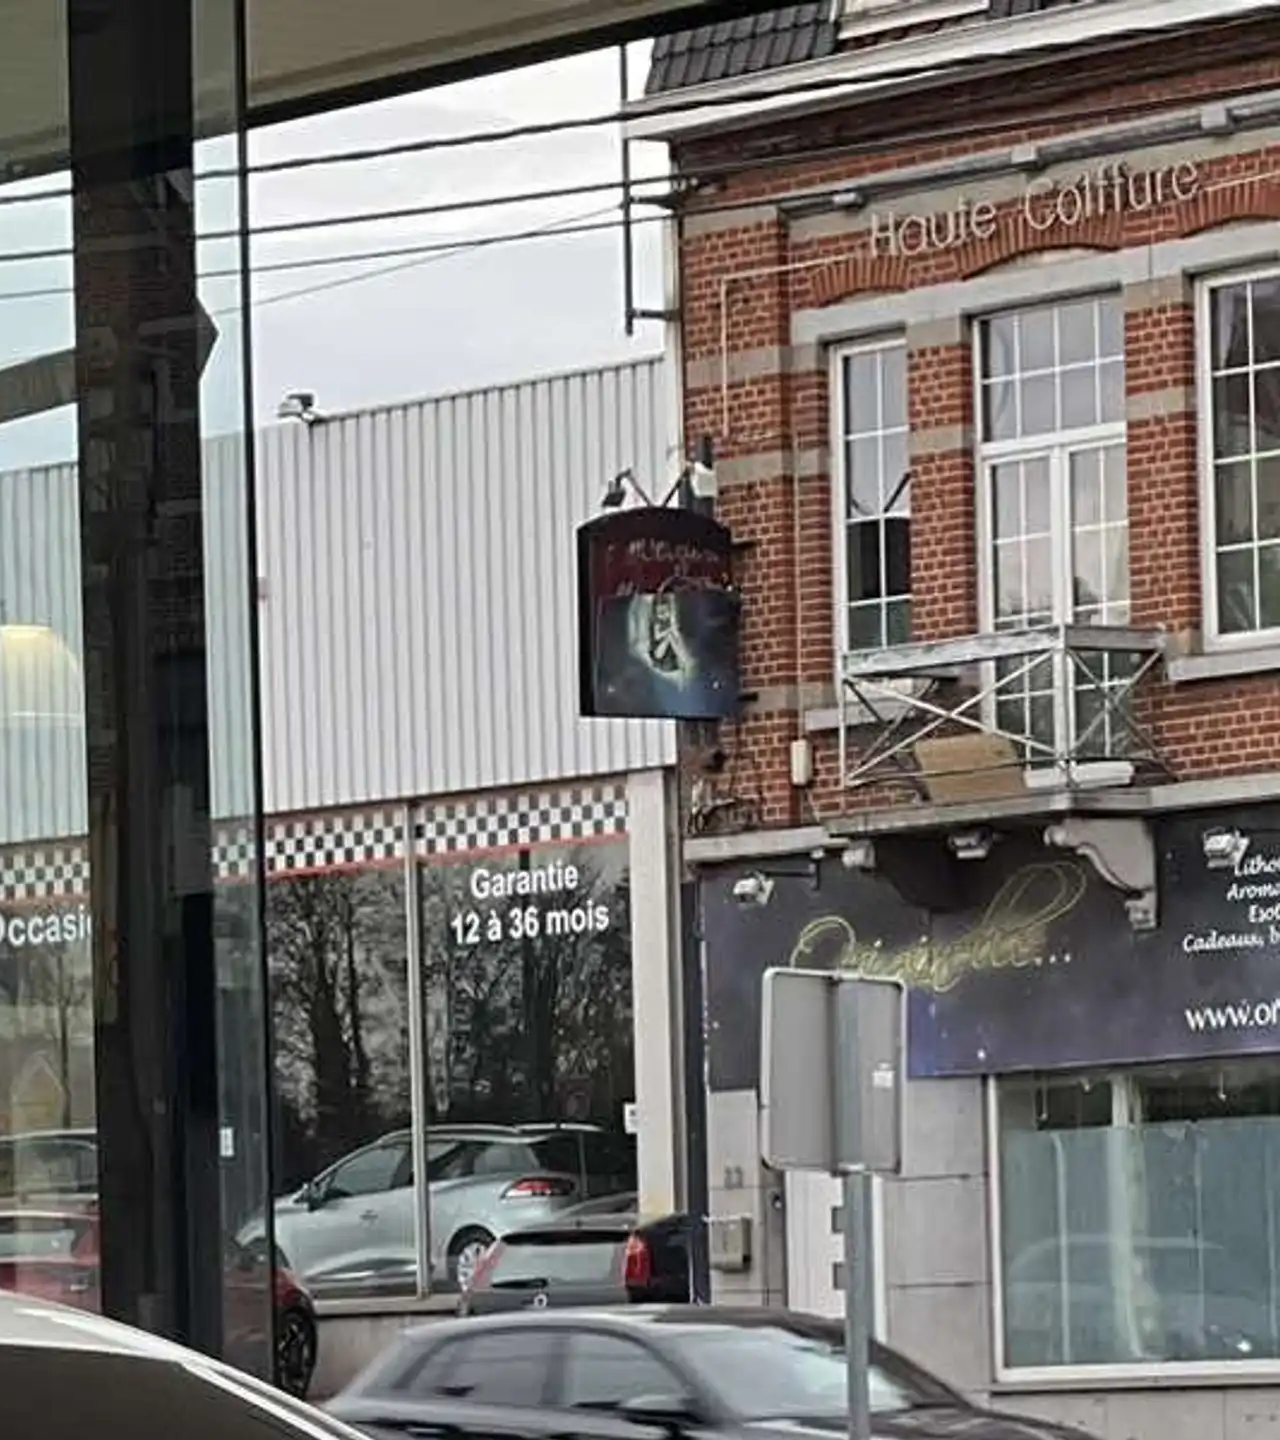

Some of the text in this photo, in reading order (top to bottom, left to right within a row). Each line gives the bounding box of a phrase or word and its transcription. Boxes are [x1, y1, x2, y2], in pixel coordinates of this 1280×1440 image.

[871, 159, 1199, 257] Haute Coiffure
[470, 859, 579, 899] Garantie
[450, 899, 610, 945] 12 à 36 mois
